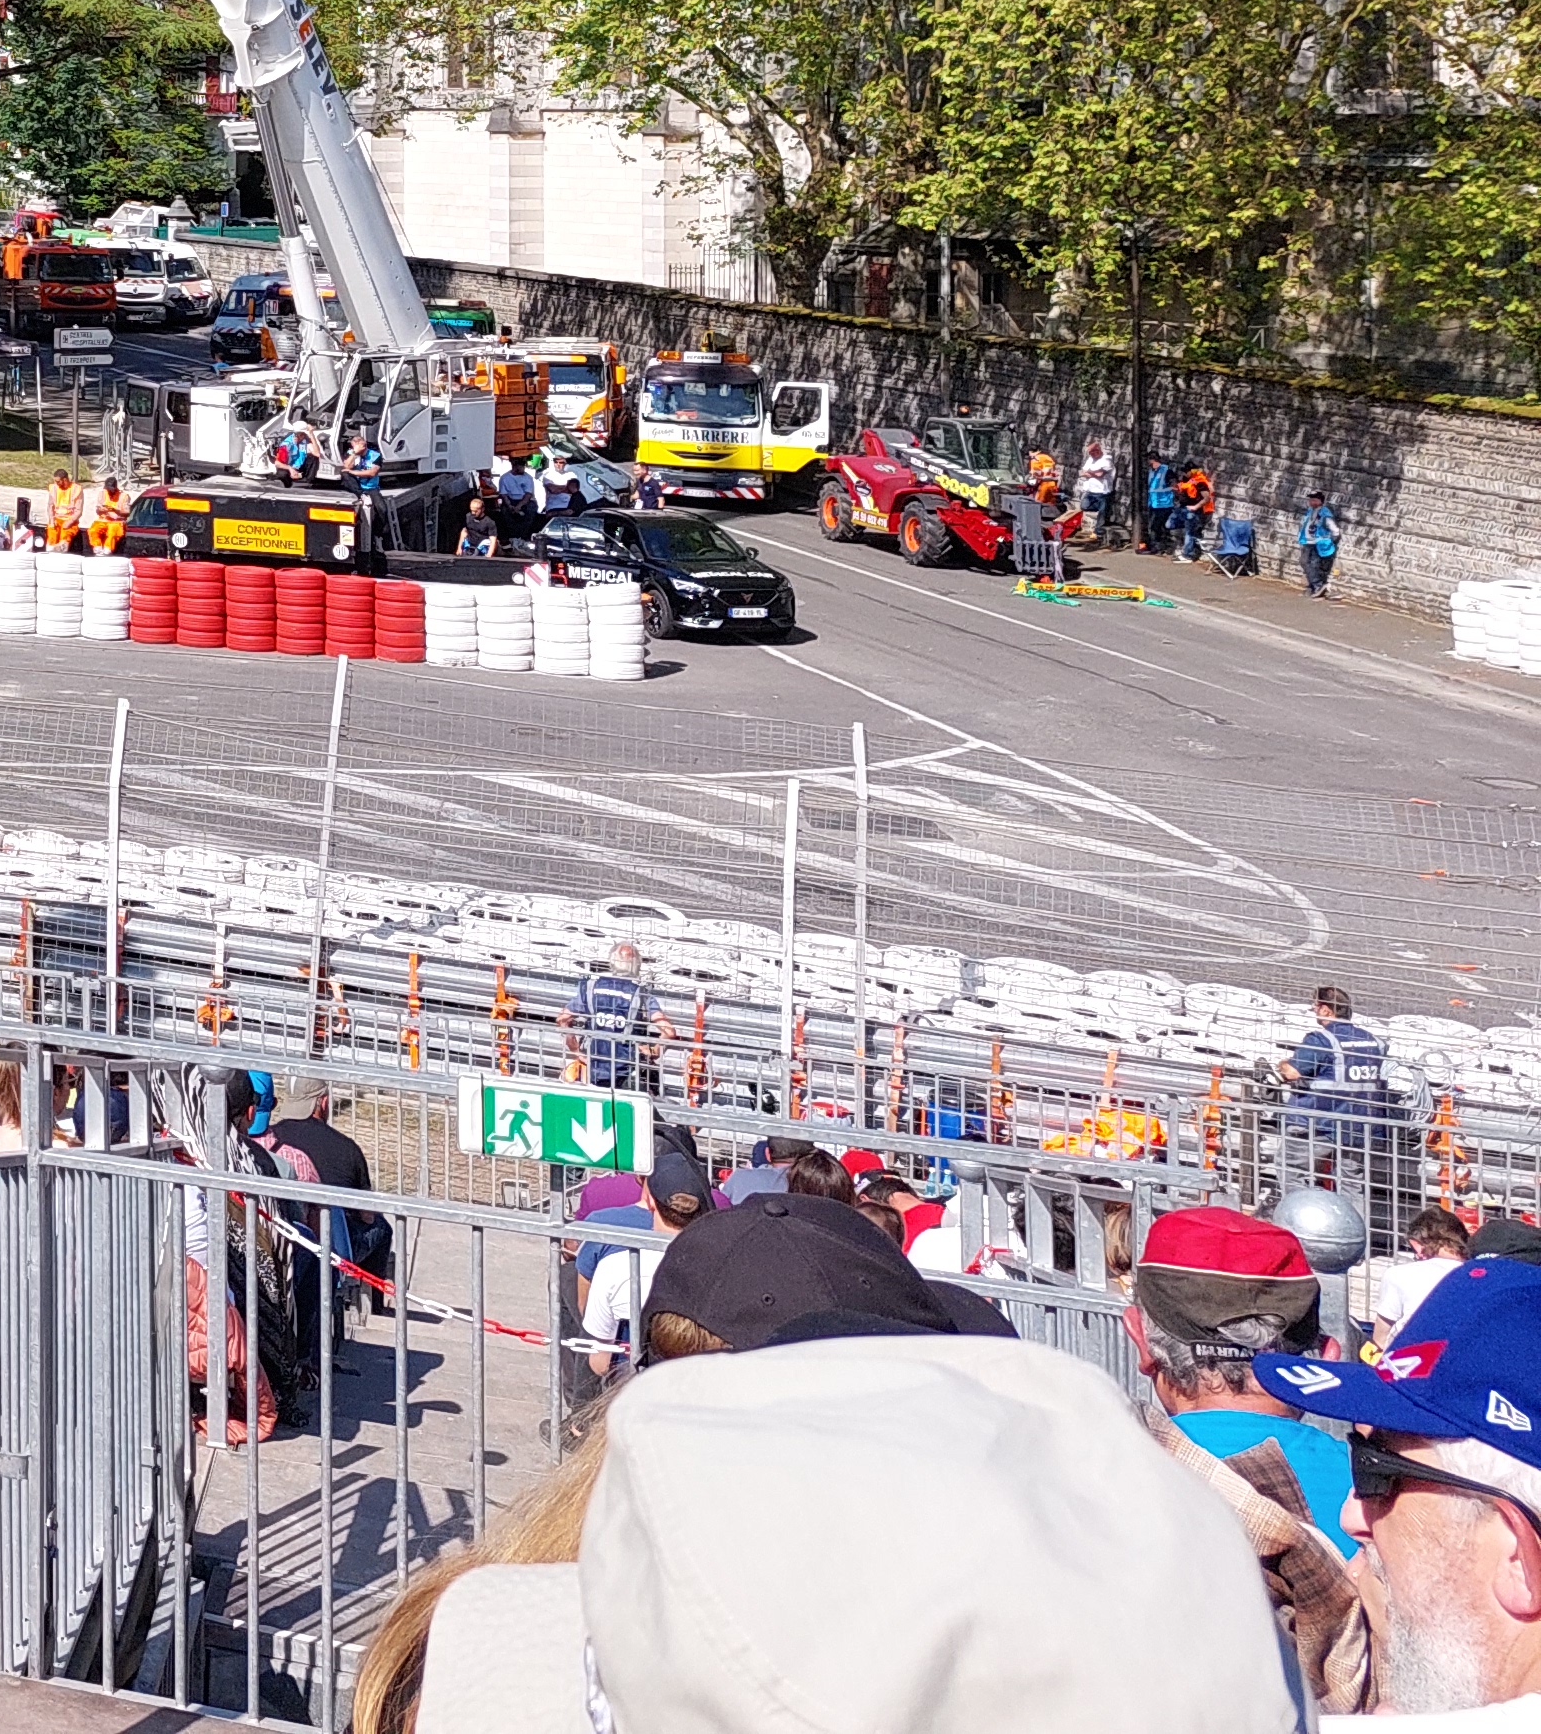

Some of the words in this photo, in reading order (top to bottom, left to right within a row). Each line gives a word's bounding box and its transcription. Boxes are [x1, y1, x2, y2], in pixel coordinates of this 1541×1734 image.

[237, 524, 281, 537] CONVOI
[216, 535, 302, 552] EXCEPTIONNEL
[567, 565, 633, 584] MEDICAL
[1068, 586, 1134, 597] MECANIQUE
[596, 1012, 626, 1028] 020
[1349, 1066, 1378, 1080] 032
